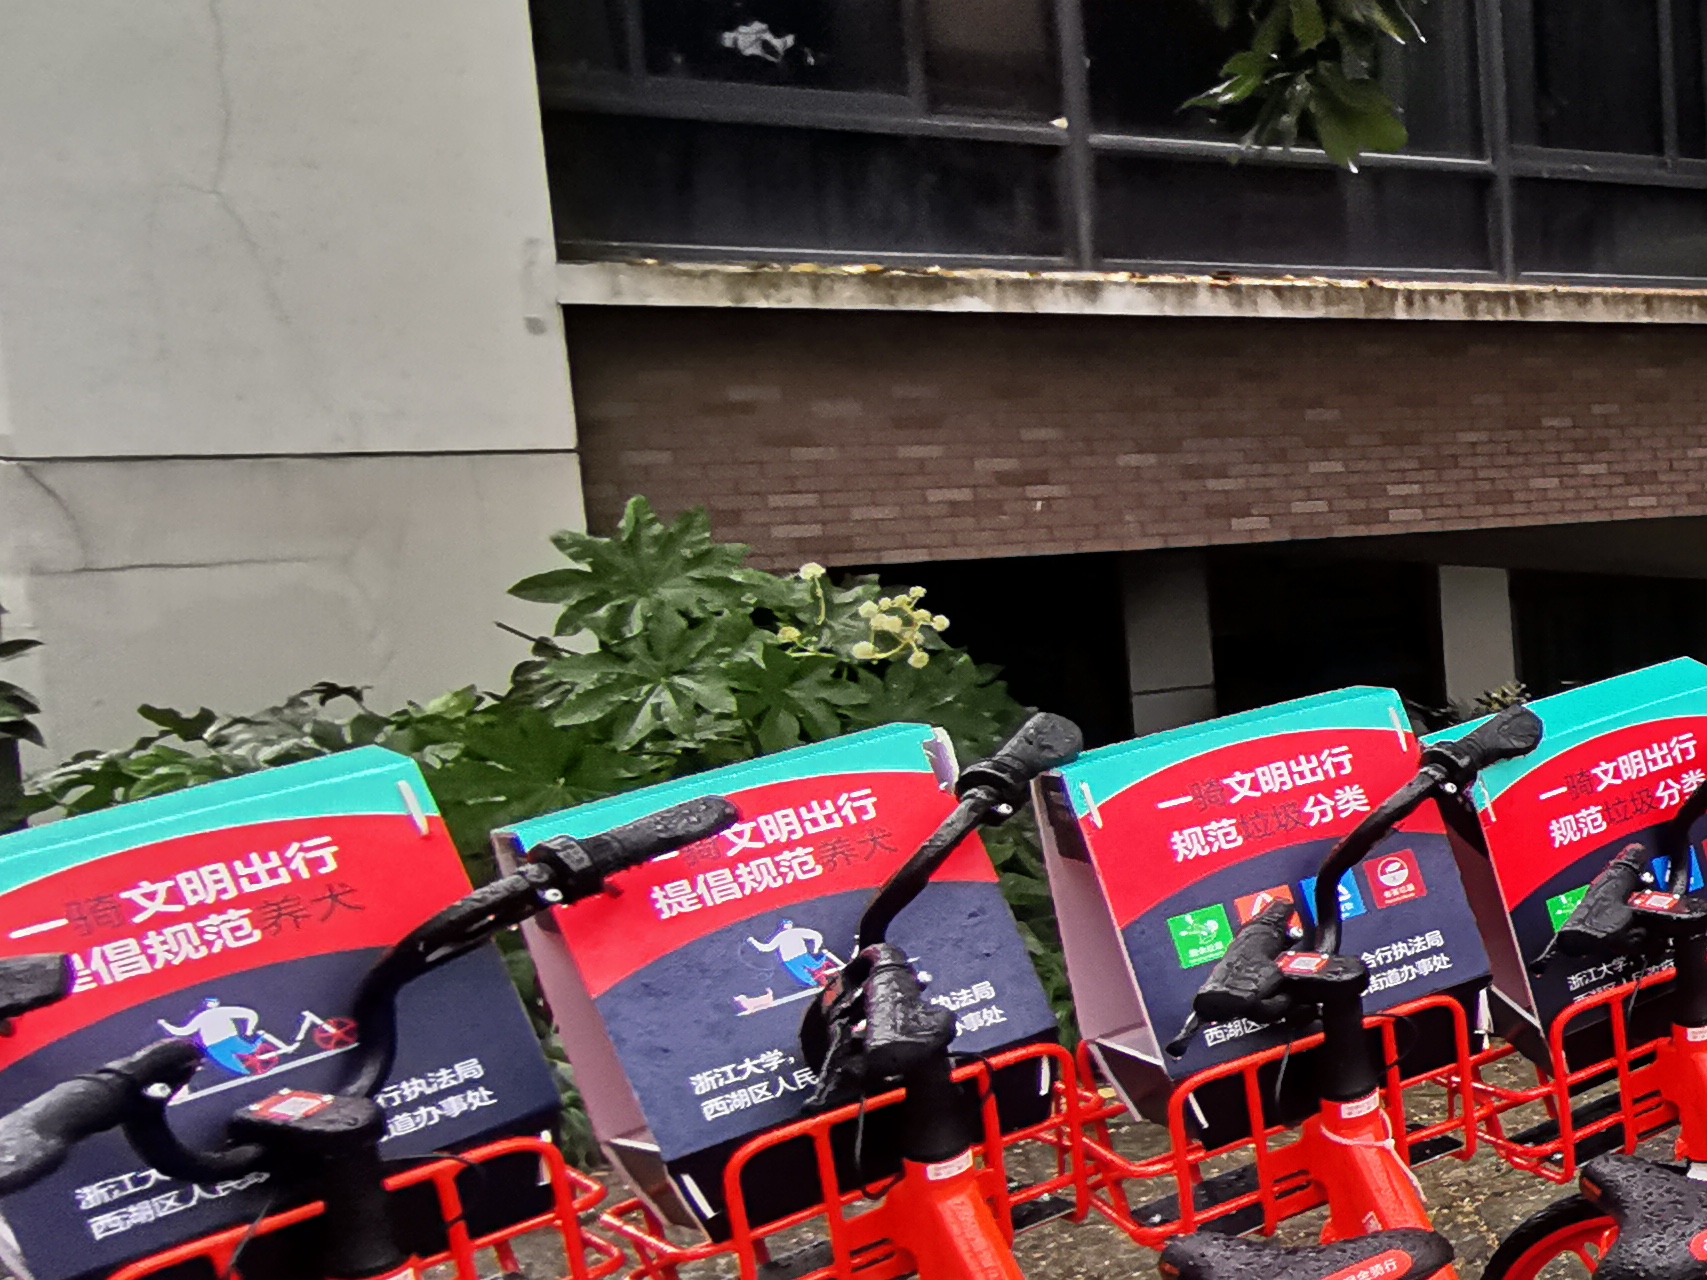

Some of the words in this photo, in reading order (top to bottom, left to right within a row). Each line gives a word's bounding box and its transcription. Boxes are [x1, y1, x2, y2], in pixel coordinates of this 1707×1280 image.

[1156, 745, 1355, 811] 一骑文明出行
[1539, 731, 1698, 802] 一骑文明出行
[1171, 783, 1371, 863] 规范垃圾分类
[1549, 769, 1707, 849] 规范垃圾分类
[8, 835, 340, 940] 一骑文明出行
[650, 826, 900, 922] 提倡规范养犬
